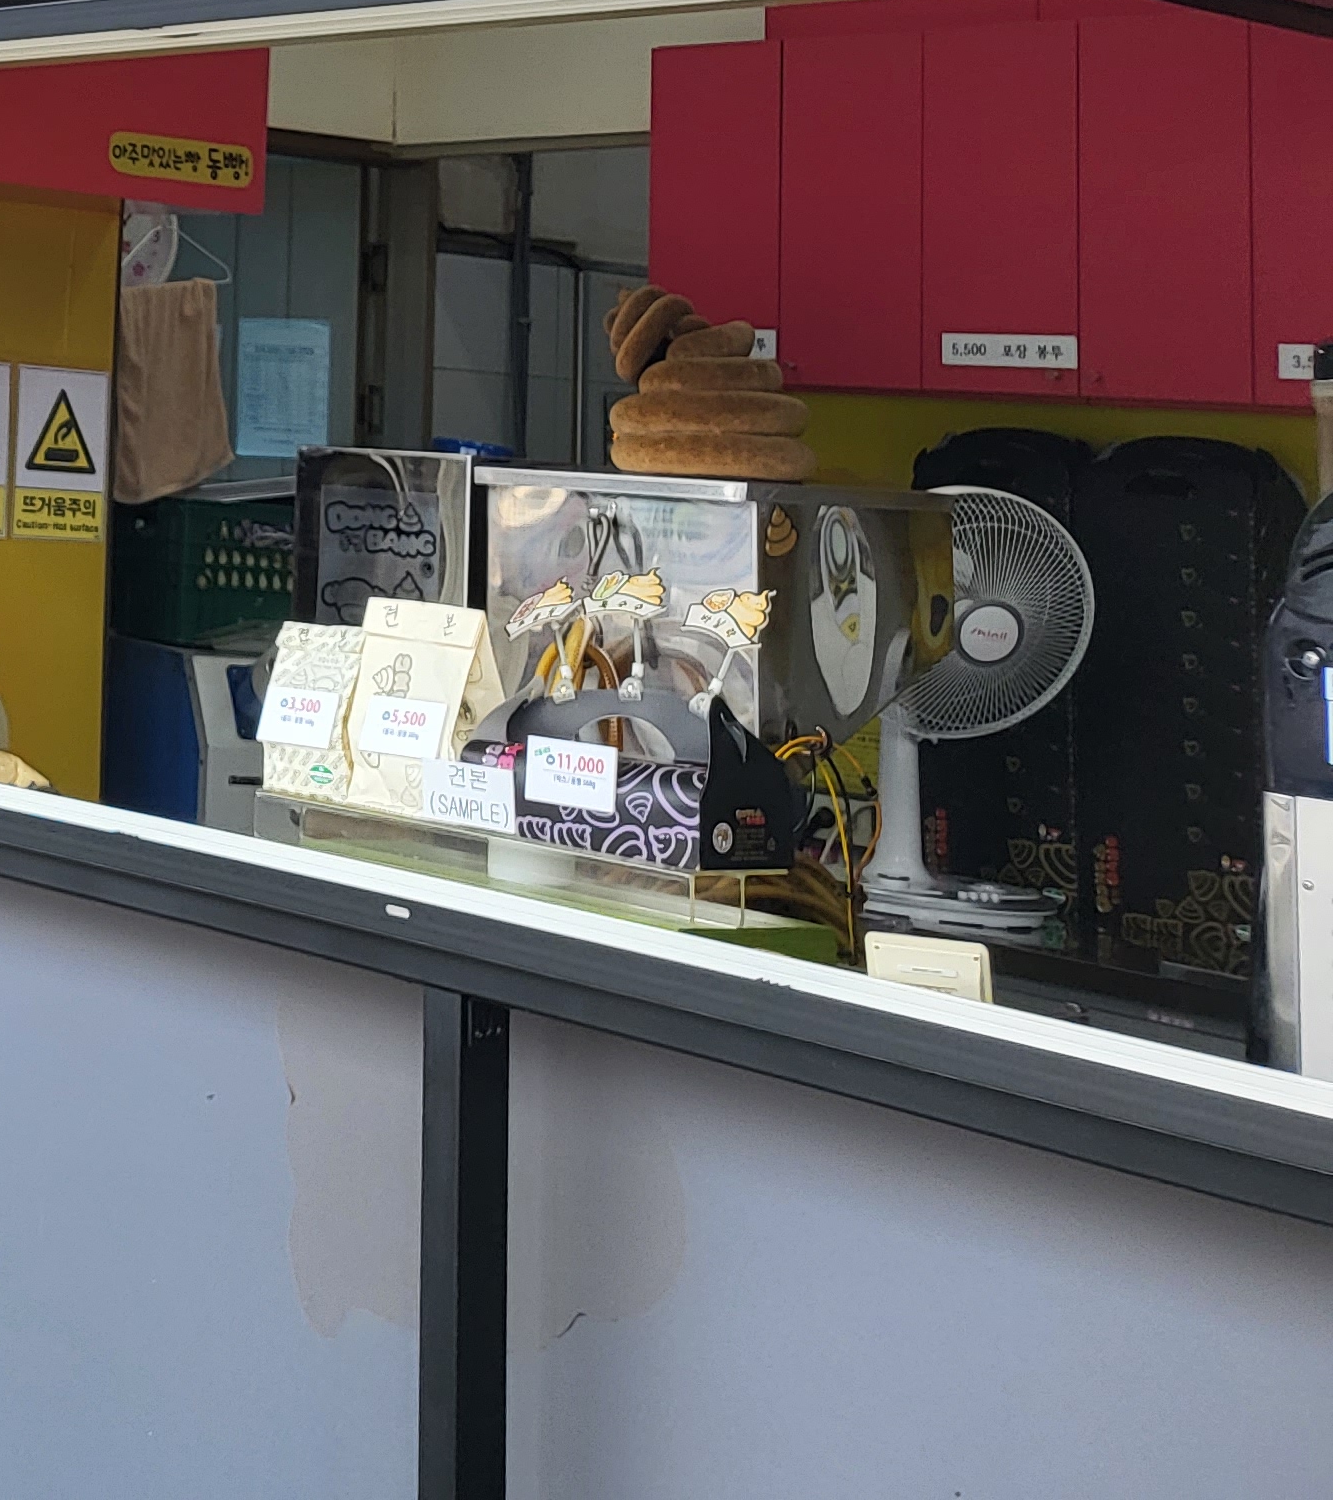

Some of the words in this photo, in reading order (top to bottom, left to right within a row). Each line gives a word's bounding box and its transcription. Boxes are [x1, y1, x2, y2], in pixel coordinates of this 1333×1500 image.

[112, 142, 202, 173] 아주맛있는빵
[951, 342, 987, 357] 5,500
[21, 495, 96, 519] 뜨거움주의
[288, 696, 321, 714] 3,500
[390, 709, 426, 728] 5,500
[557, 752, 605, 775] 11,000
[448, 764, 488, 793] 견본
[429, 790, 509, 828] (SAMPLE)
